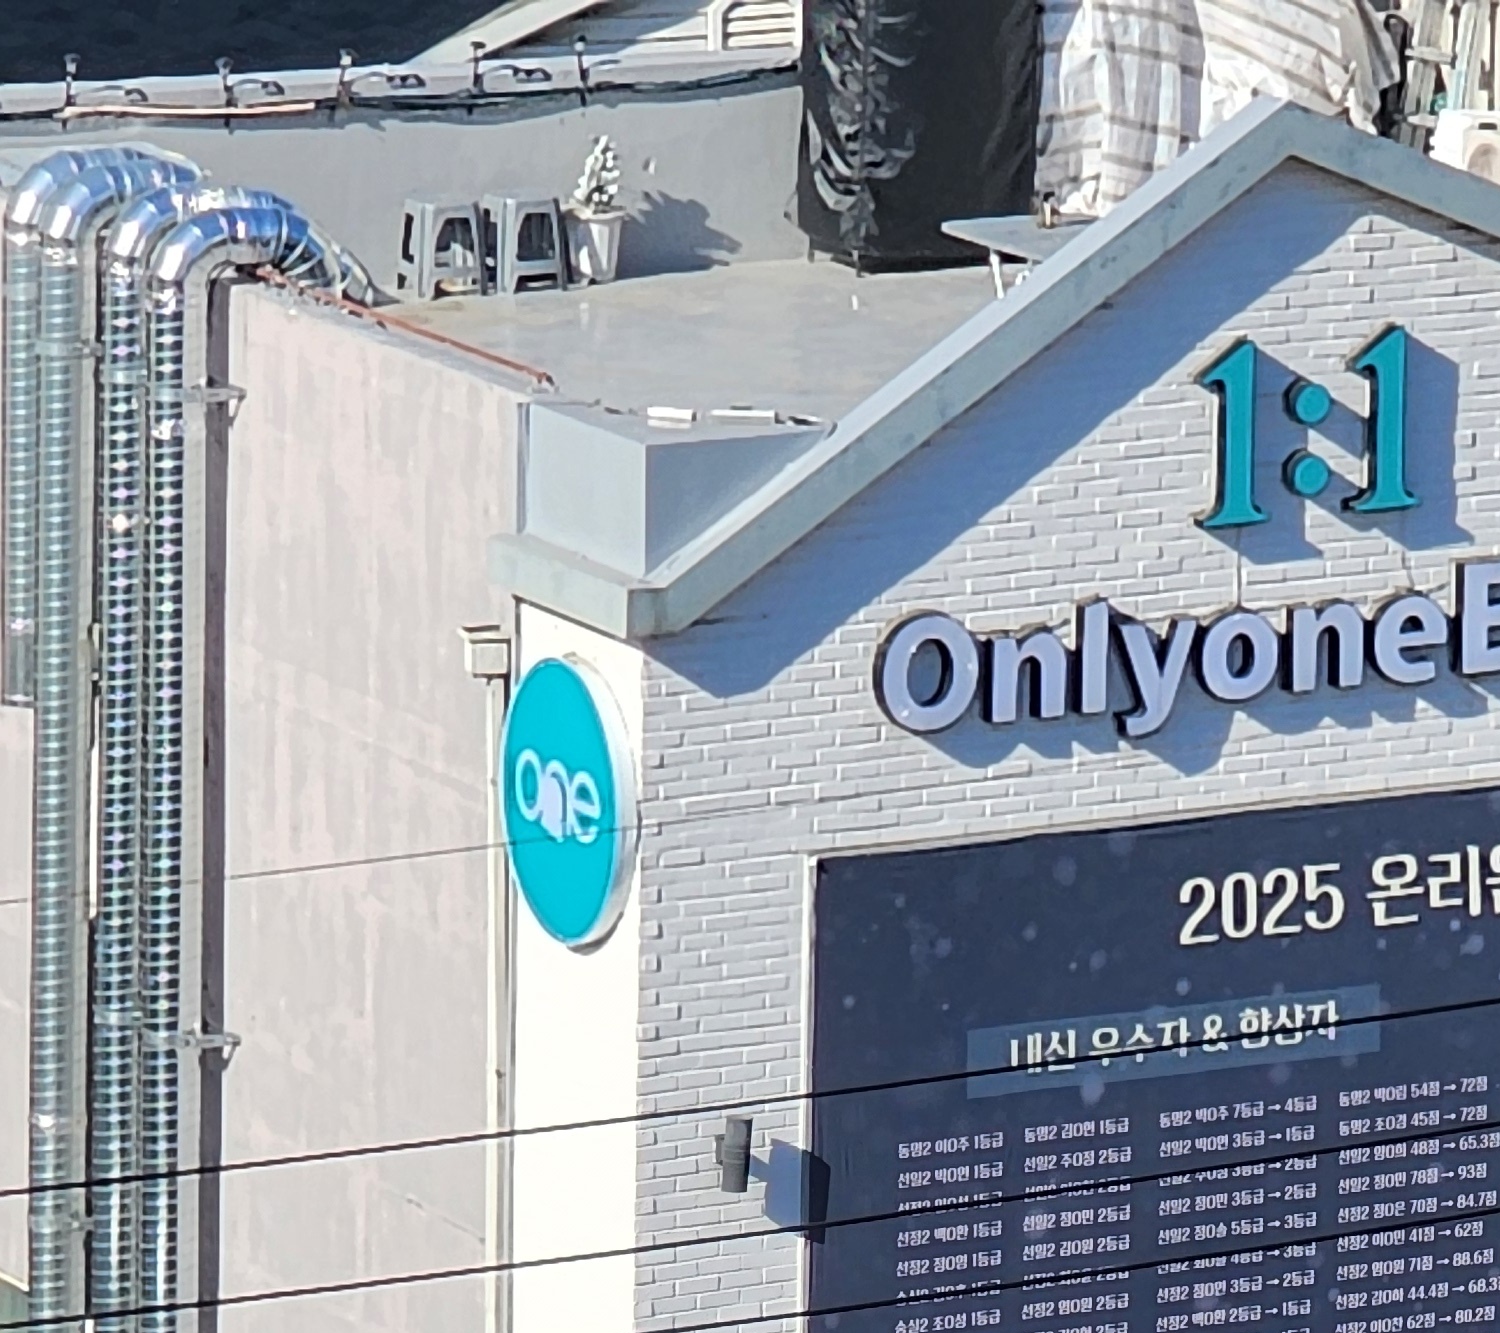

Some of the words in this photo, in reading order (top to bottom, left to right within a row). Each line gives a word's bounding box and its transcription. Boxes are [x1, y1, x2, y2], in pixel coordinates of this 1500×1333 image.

[1194, 323, 1421, 529] 1:1
[1178, 862, 1344, 946] 2025
[1010, 1029, 1076, 1074] 내신
[1089, 1016, 1191, 1067] 우수자
[1202, 1014, 1229, 1053] &
[1238, 1000, 1340, 1050] 향상자
